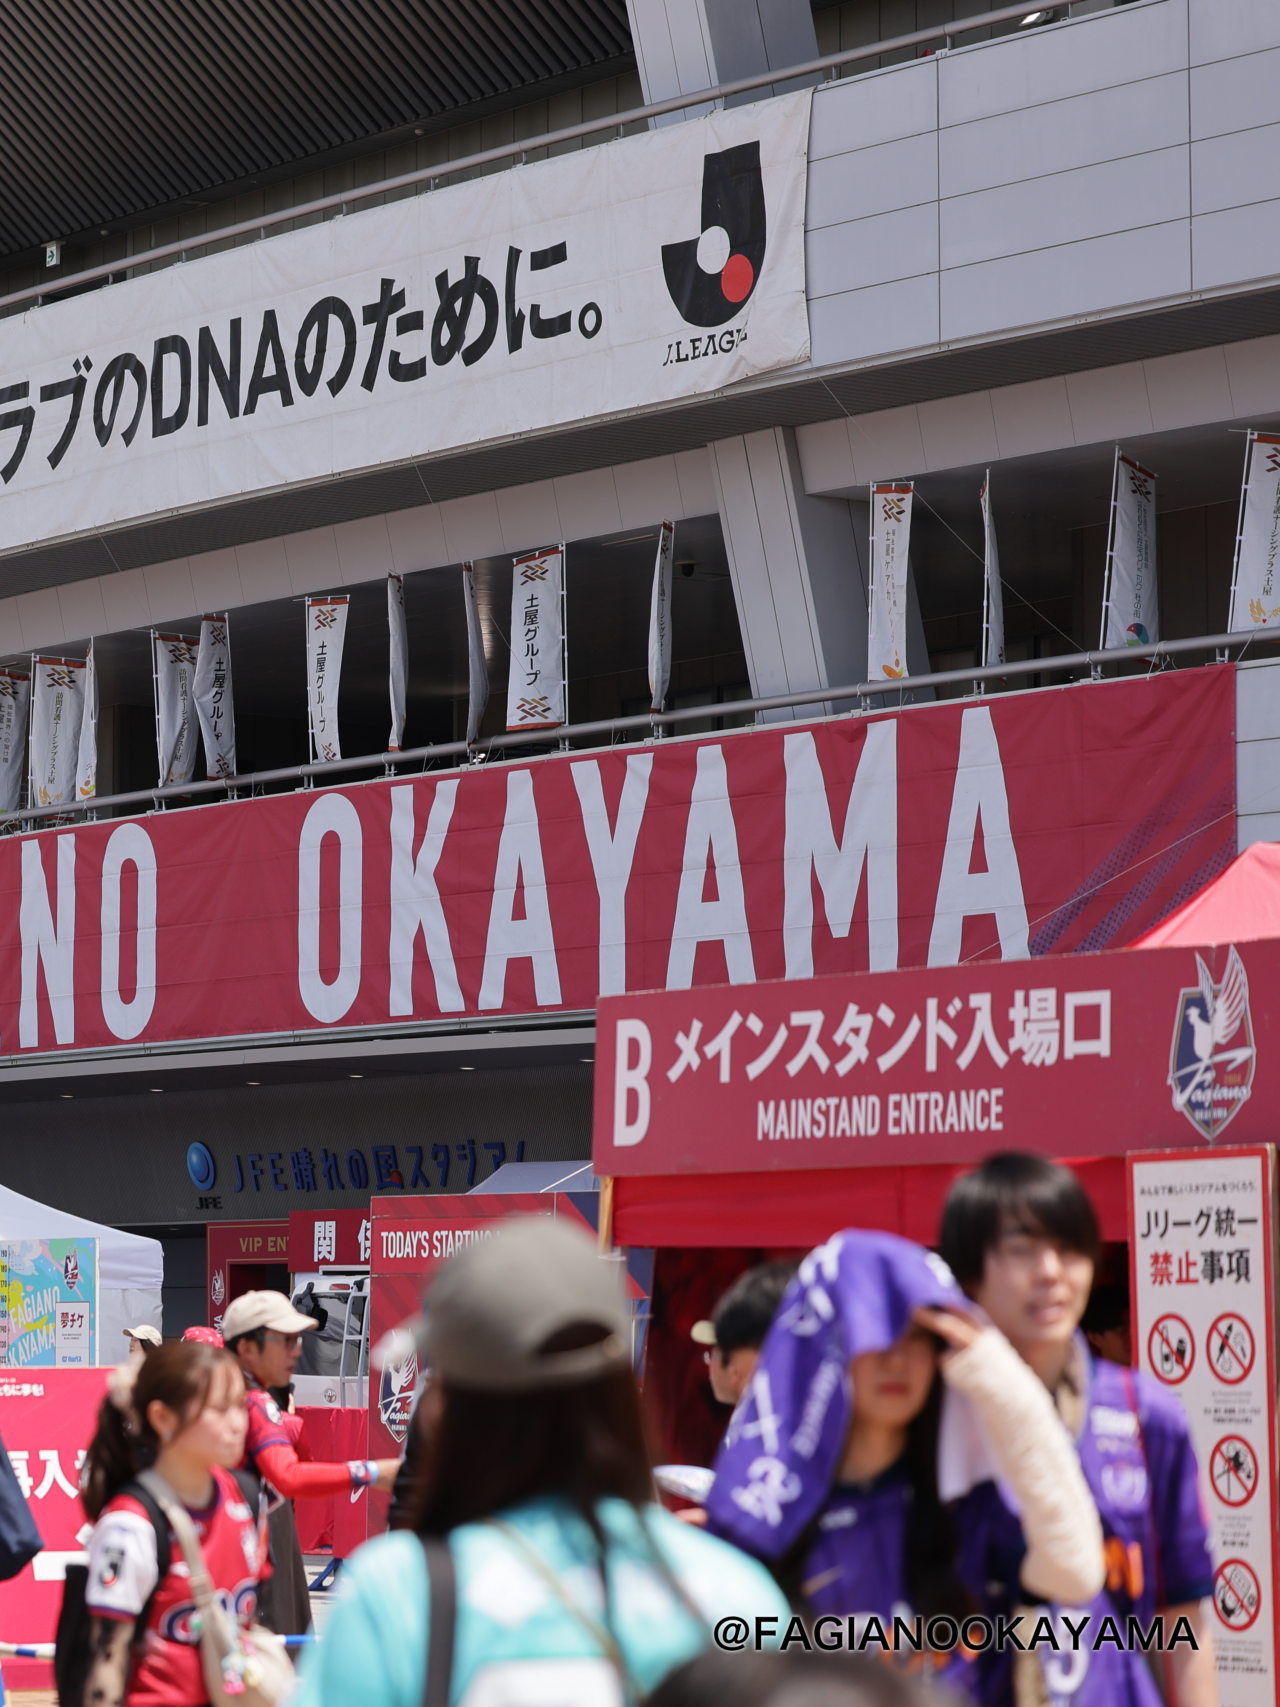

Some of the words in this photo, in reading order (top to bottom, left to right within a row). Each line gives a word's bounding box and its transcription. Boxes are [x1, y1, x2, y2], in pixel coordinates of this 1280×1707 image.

[523, 593, 541, 686] 土屋グループ
[210, 658, 226, 741] 土屋グループ
[315, 641, 328, 733] 土屋グループ
[47, 692, 64, 785] 訪問看護ナーシングプラス土屋
[298, 706, 1031, 1024] OKAYAMA
[613, 1018, 651, 1147] B
[667, 987, 1111, 1083] メインスタンド入場口
[757, 1094, 881, 1142] MAINSTAND
[887, 1088, 1004, 1136] ENTRANCE
[196, 1196, 223, 1210] JFE
[1141, 1206, 1258, 1239] Jリーグ統一
[239, 1236, 263, 1253] VIP
[381, 1230, 429, 1260] TODAY'S
[1150, 1248, 1251, 1286] 禁止事項
[9, 1286, 60, 1334] FAGIANO
[61, 1312, 84, 1328] 夢チケ
[8, 1325, 55, 1368] KAYAMA
